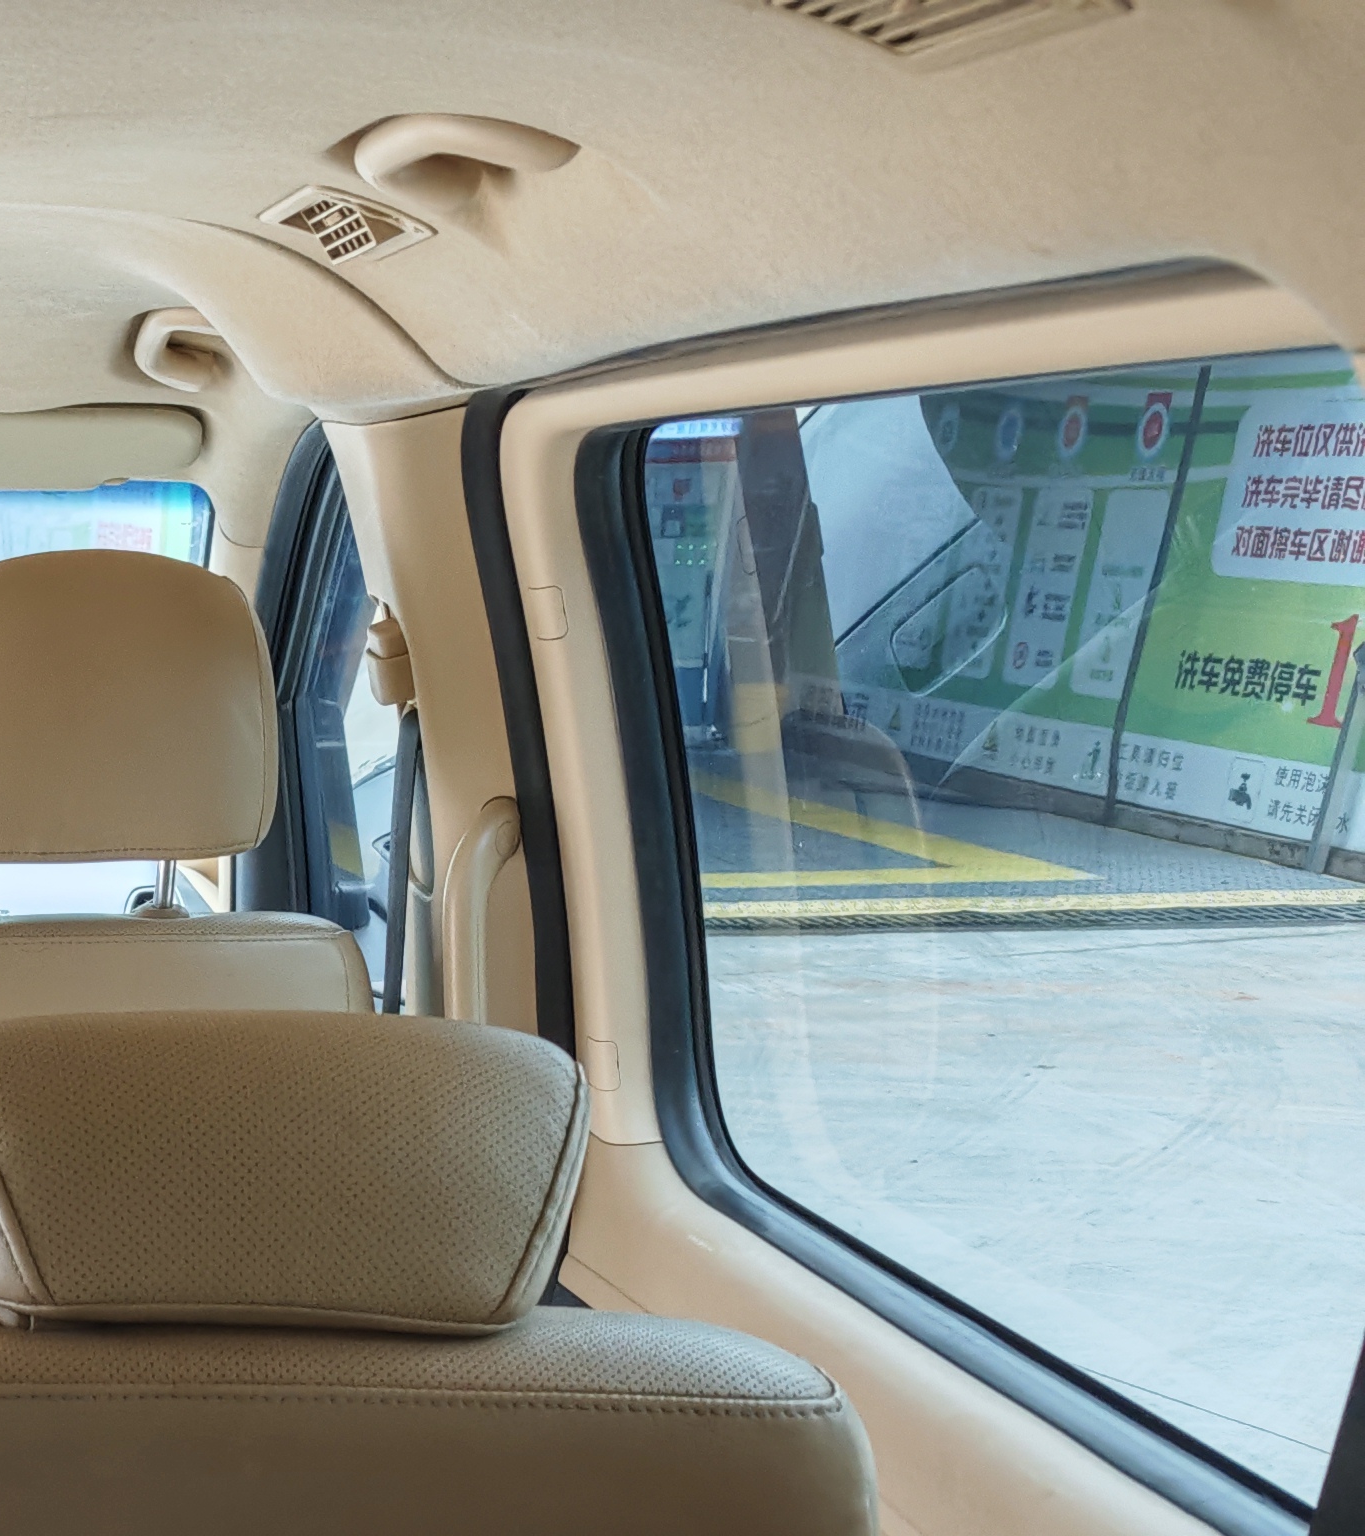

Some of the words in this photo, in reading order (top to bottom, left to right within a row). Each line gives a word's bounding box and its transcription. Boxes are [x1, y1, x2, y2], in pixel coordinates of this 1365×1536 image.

[1174, 649, 1321, 706] 洗车免费停车
